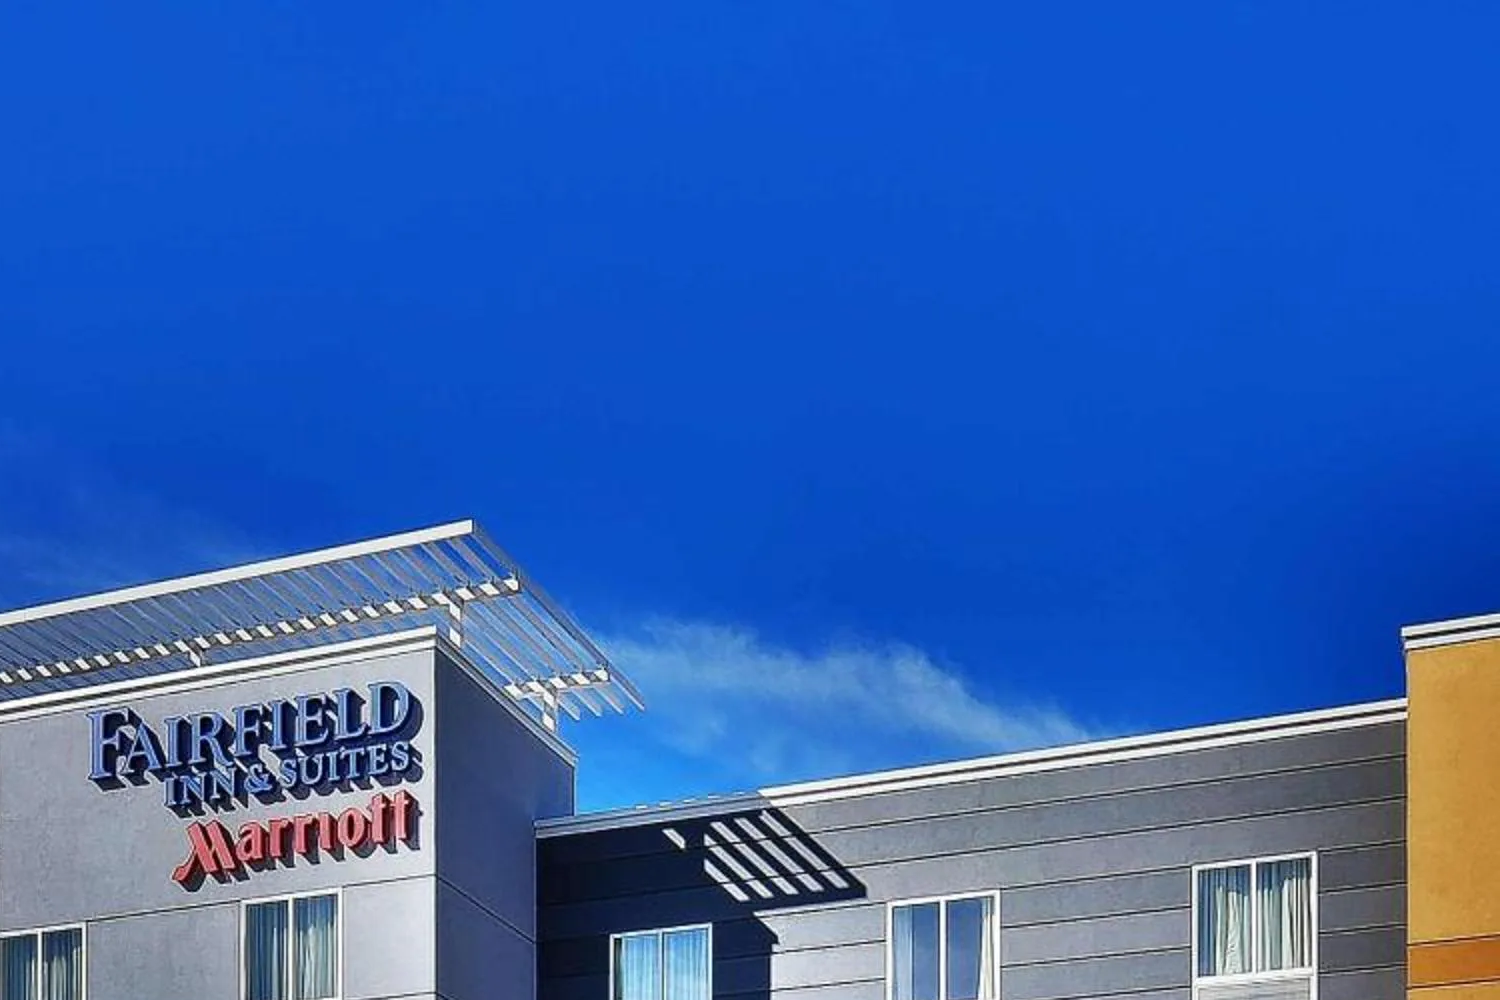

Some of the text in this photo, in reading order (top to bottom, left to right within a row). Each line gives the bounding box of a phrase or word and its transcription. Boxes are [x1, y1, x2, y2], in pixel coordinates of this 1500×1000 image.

[86, 681, 413, 782] FAIRFIELD
[278, 741, 410, 788] SUITES
[171, 790, 411, 883] Marriott
